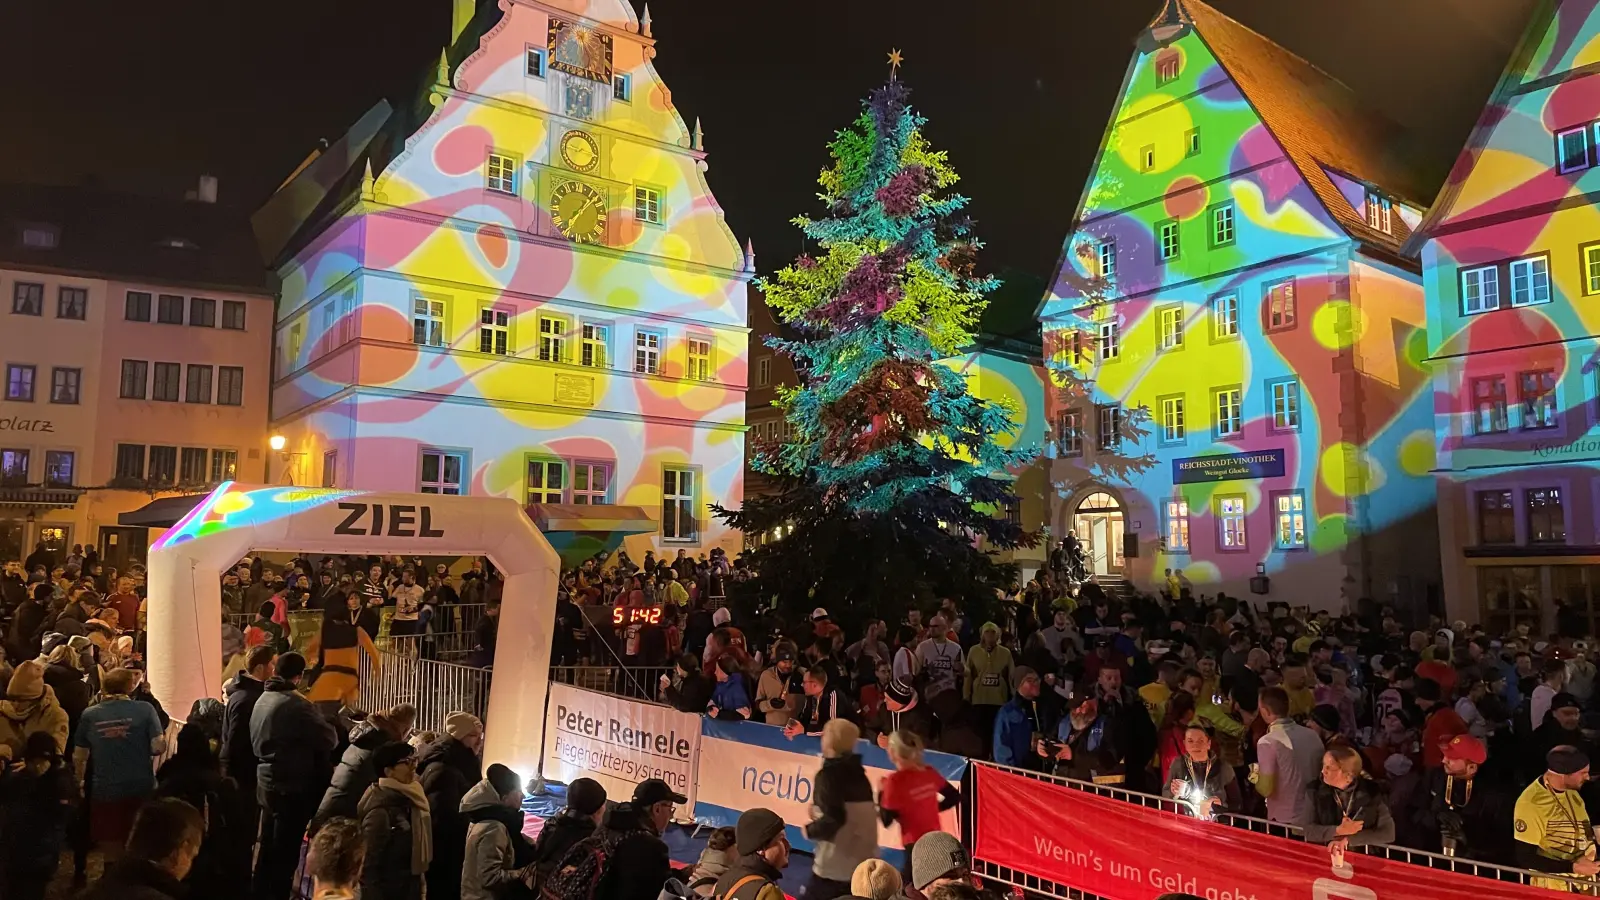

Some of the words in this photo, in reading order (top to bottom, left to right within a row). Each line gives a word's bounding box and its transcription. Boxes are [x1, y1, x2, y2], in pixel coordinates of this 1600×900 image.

[1179, 454, 1277, 470] REICHSSTADT-VINOTHEK
[334, 502, 444, 538] ZIEL
[557, 704, 603, 737] Peter
[609, 718, 690, 759] Remele
[555, 736, 687, 788] Fliegengittersysteme
[1033, 835, 1103, 872] Wenn's
[1109, 860, 1142, 882] um
[1148, 867, 1197, 896] Geld
